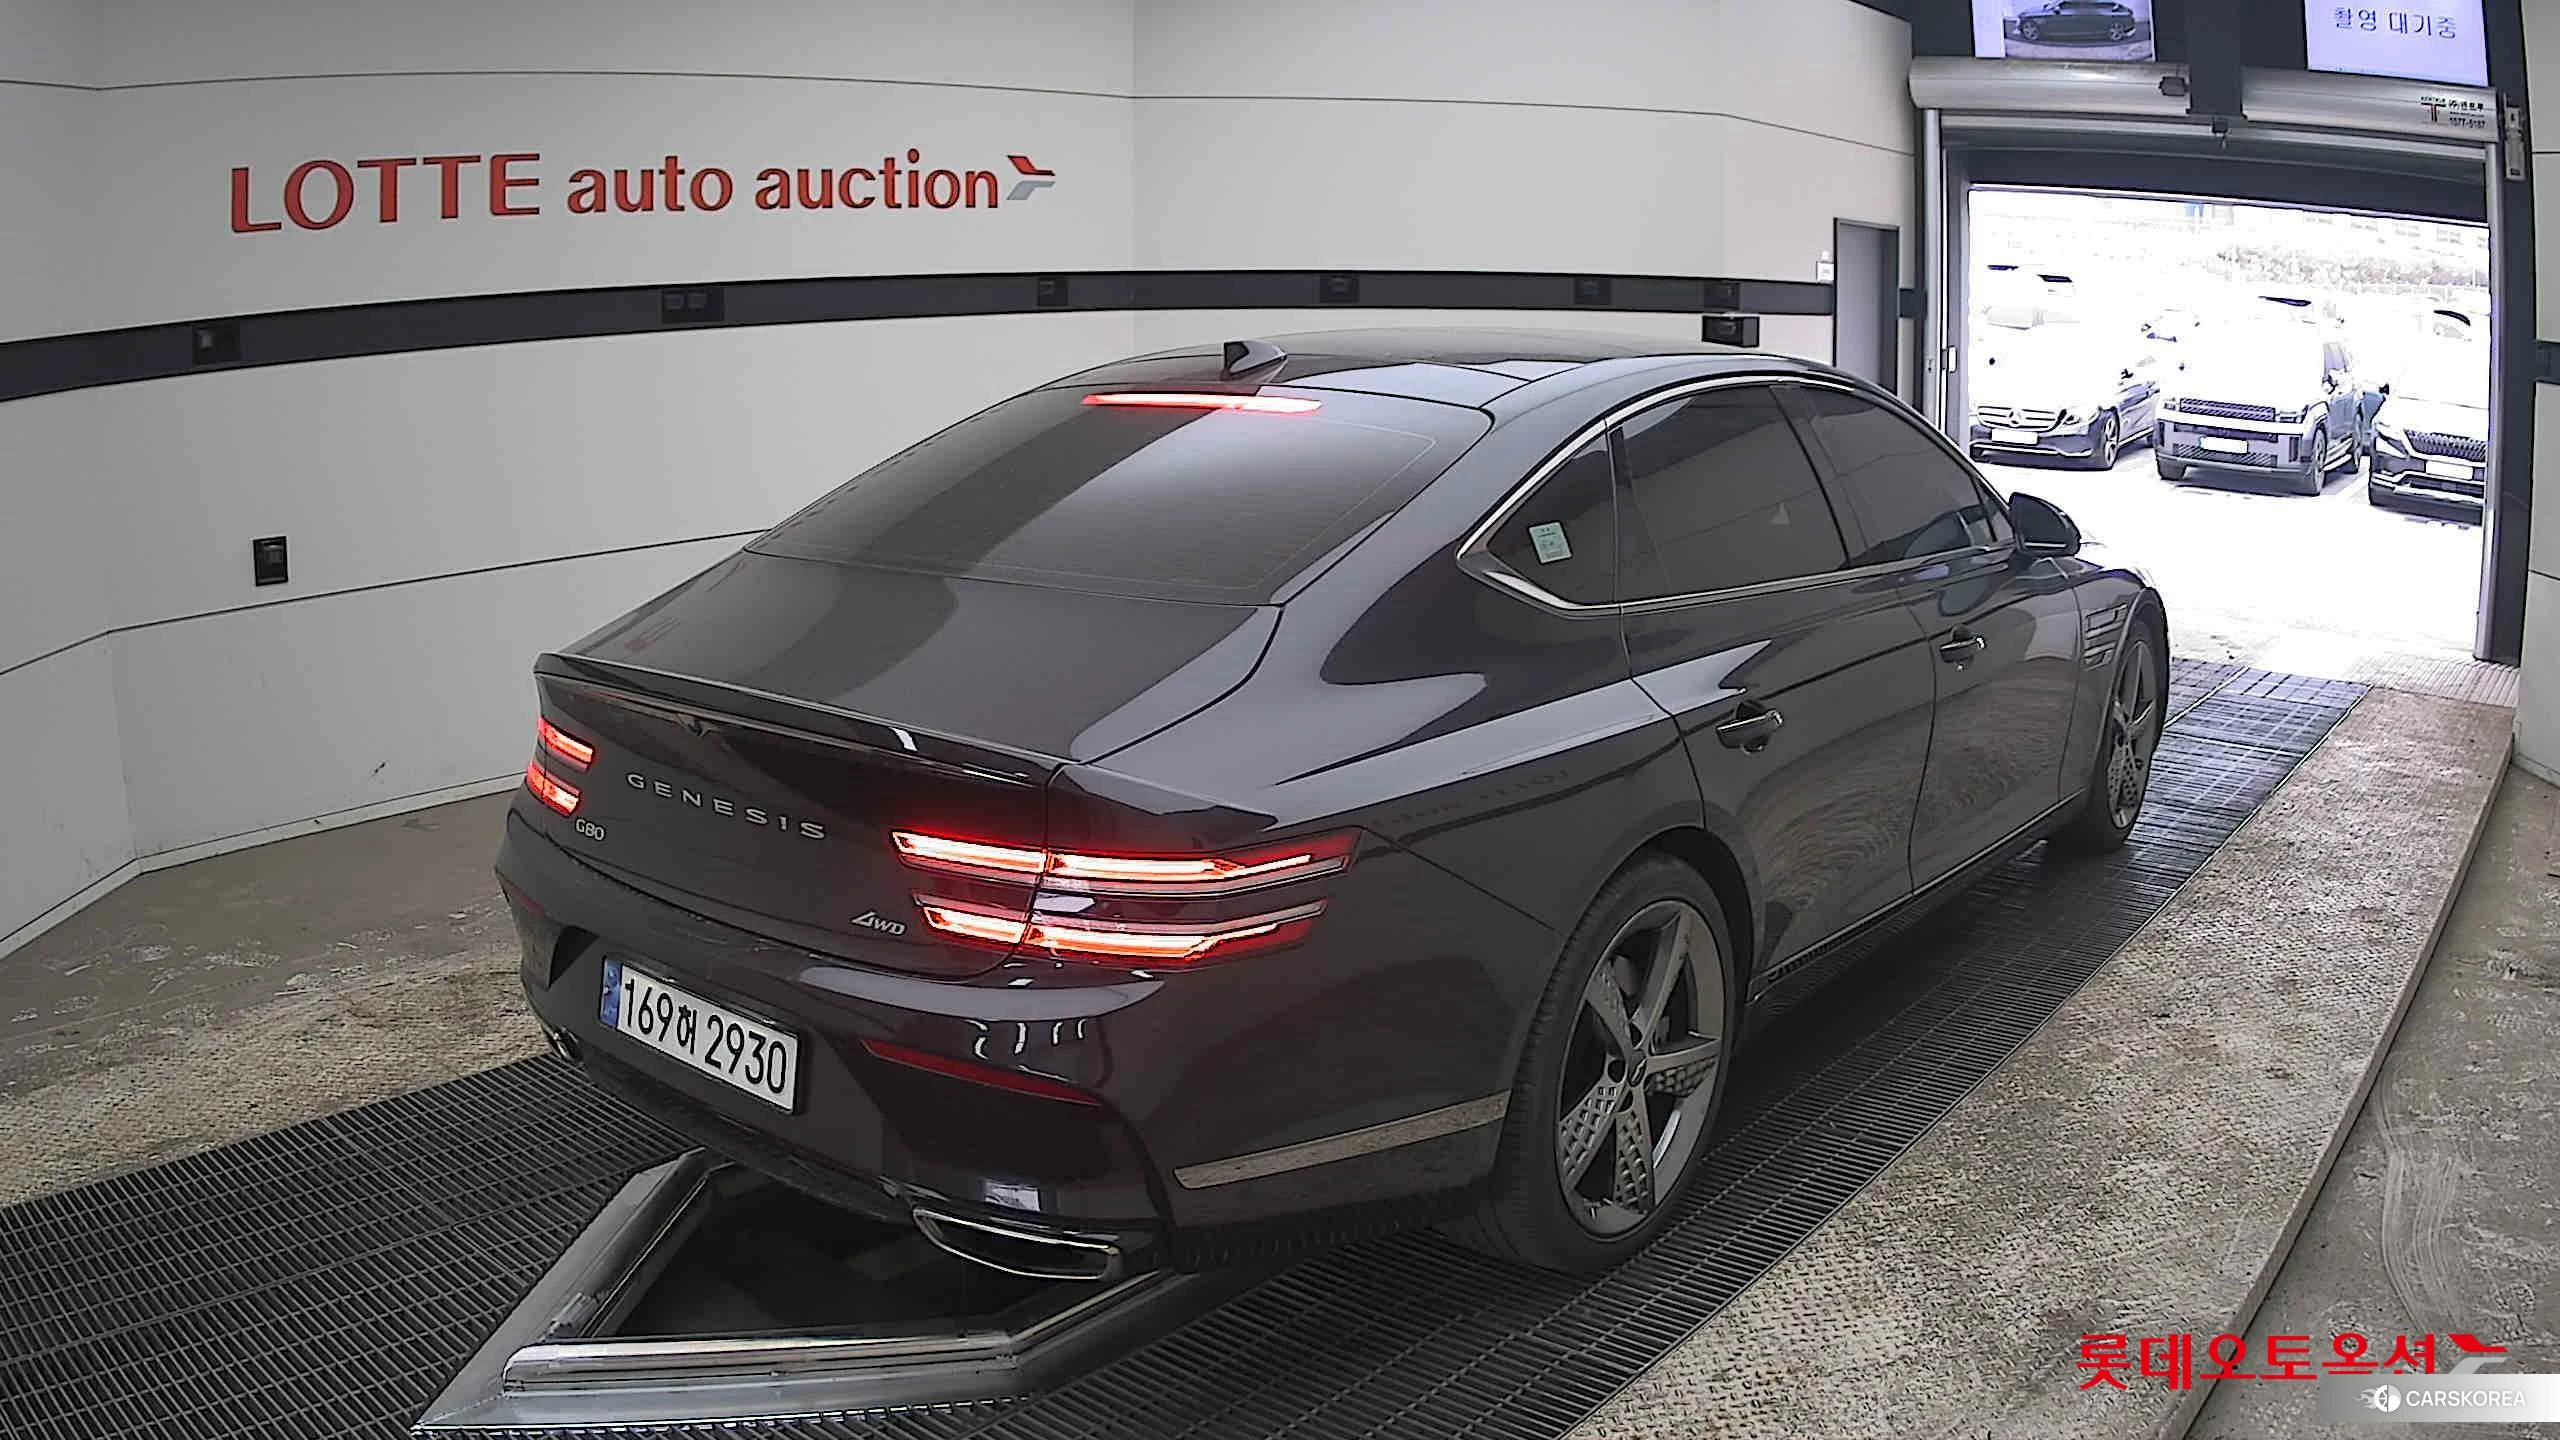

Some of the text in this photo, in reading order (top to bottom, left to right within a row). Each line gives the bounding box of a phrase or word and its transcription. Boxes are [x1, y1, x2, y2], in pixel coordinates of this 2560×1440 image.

[2389, 12, 2457, 40] 대기중
[231, 147, 1000, 233] LOTTE auto auction
[575, 818, 606, 841] G80
[627, 773, 826, 840] GENESIS
[624, 978, 698, 1056] 169허
[704, 1014, 788, 1095] 2930
